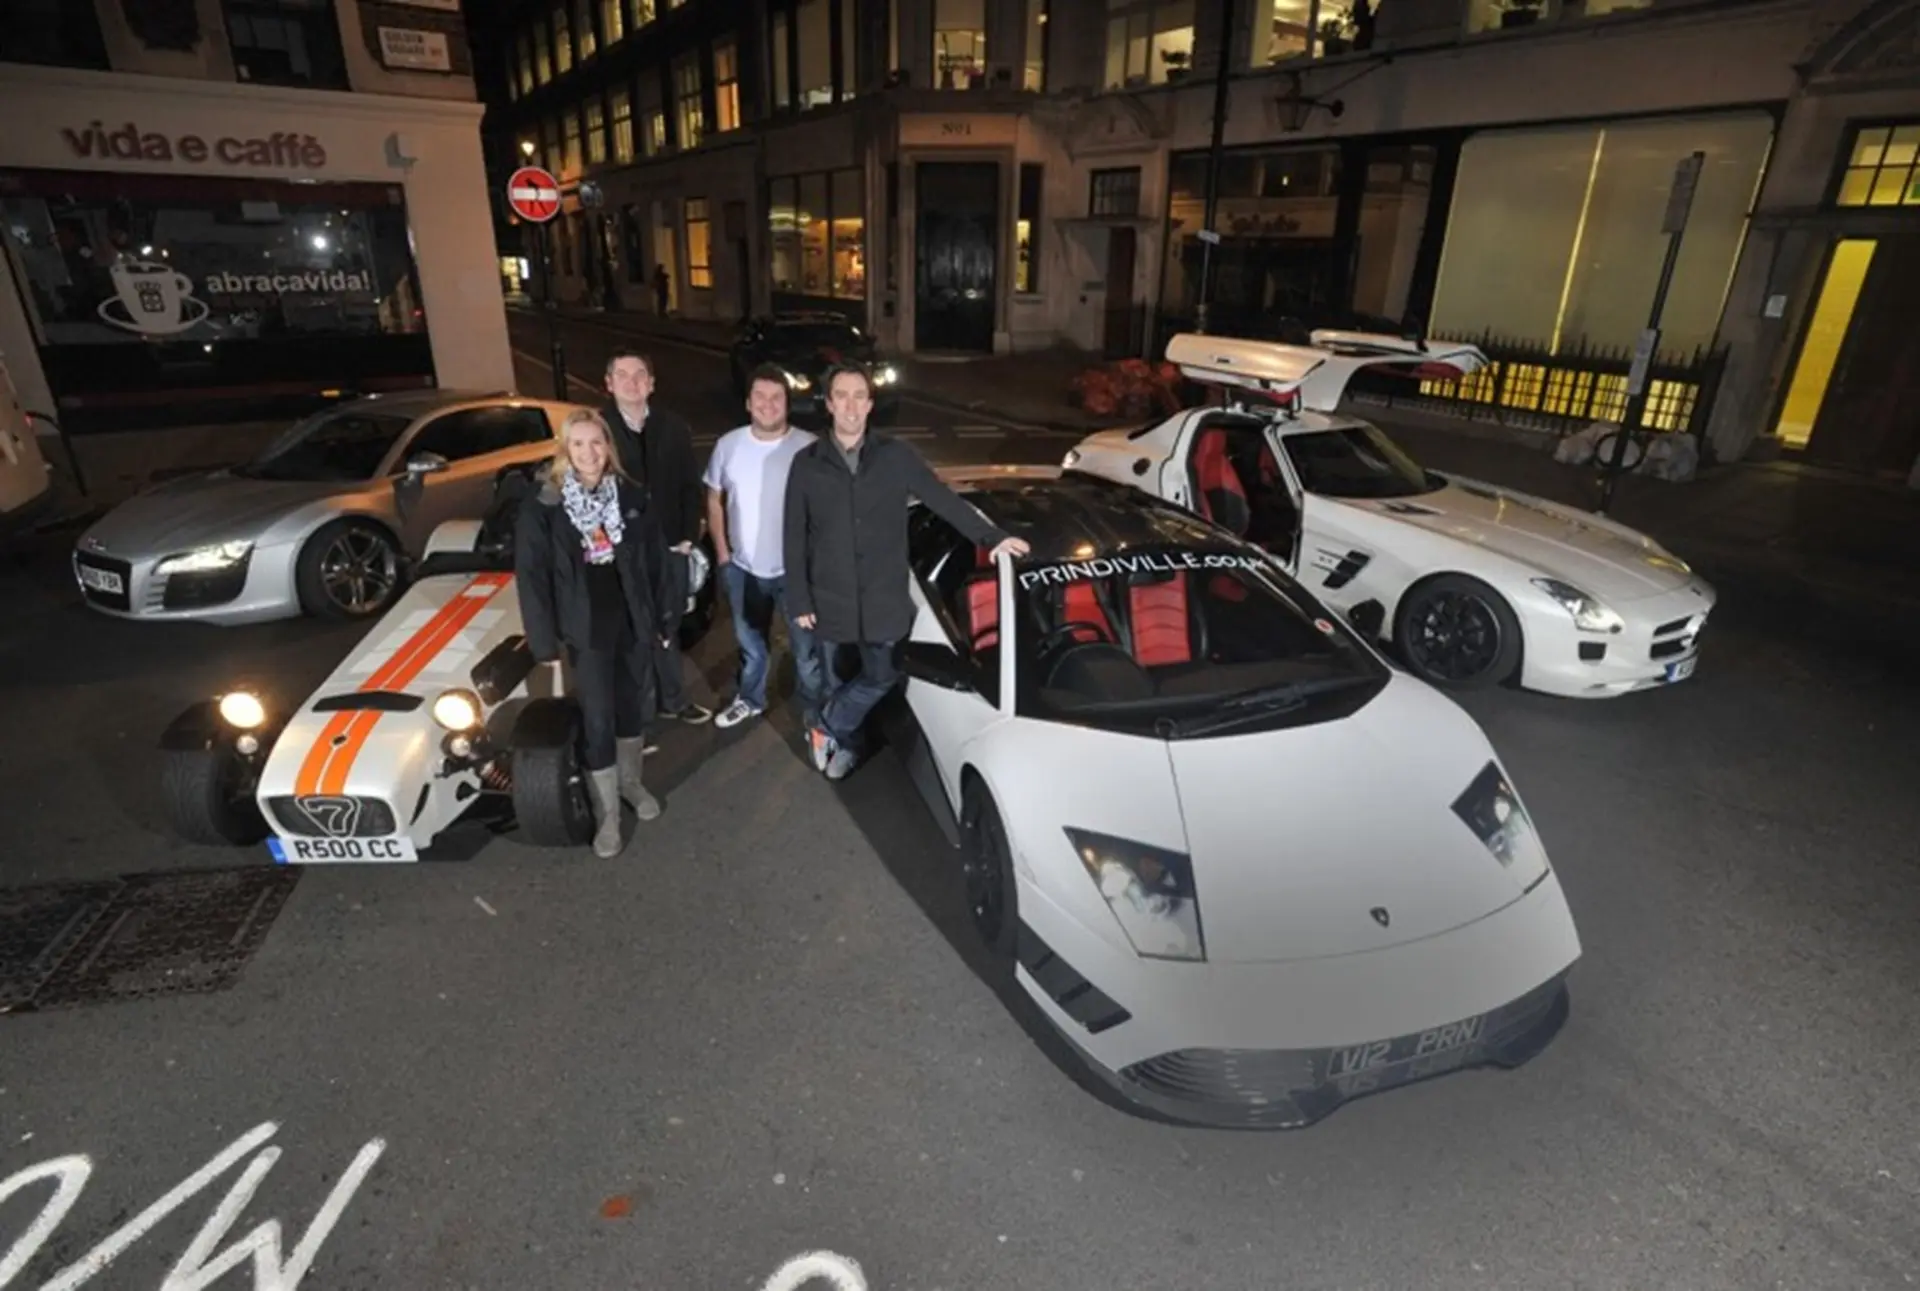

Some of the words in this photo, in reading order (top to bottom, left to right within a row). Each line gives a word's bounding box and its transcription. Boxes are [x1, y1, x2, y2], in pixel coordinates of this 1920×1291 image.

[61, 120, 173, 162] vida
[176, 134, 208, 163] e
[294, 839, 363, 859] R500
[367, 838, 403, 858] CC
